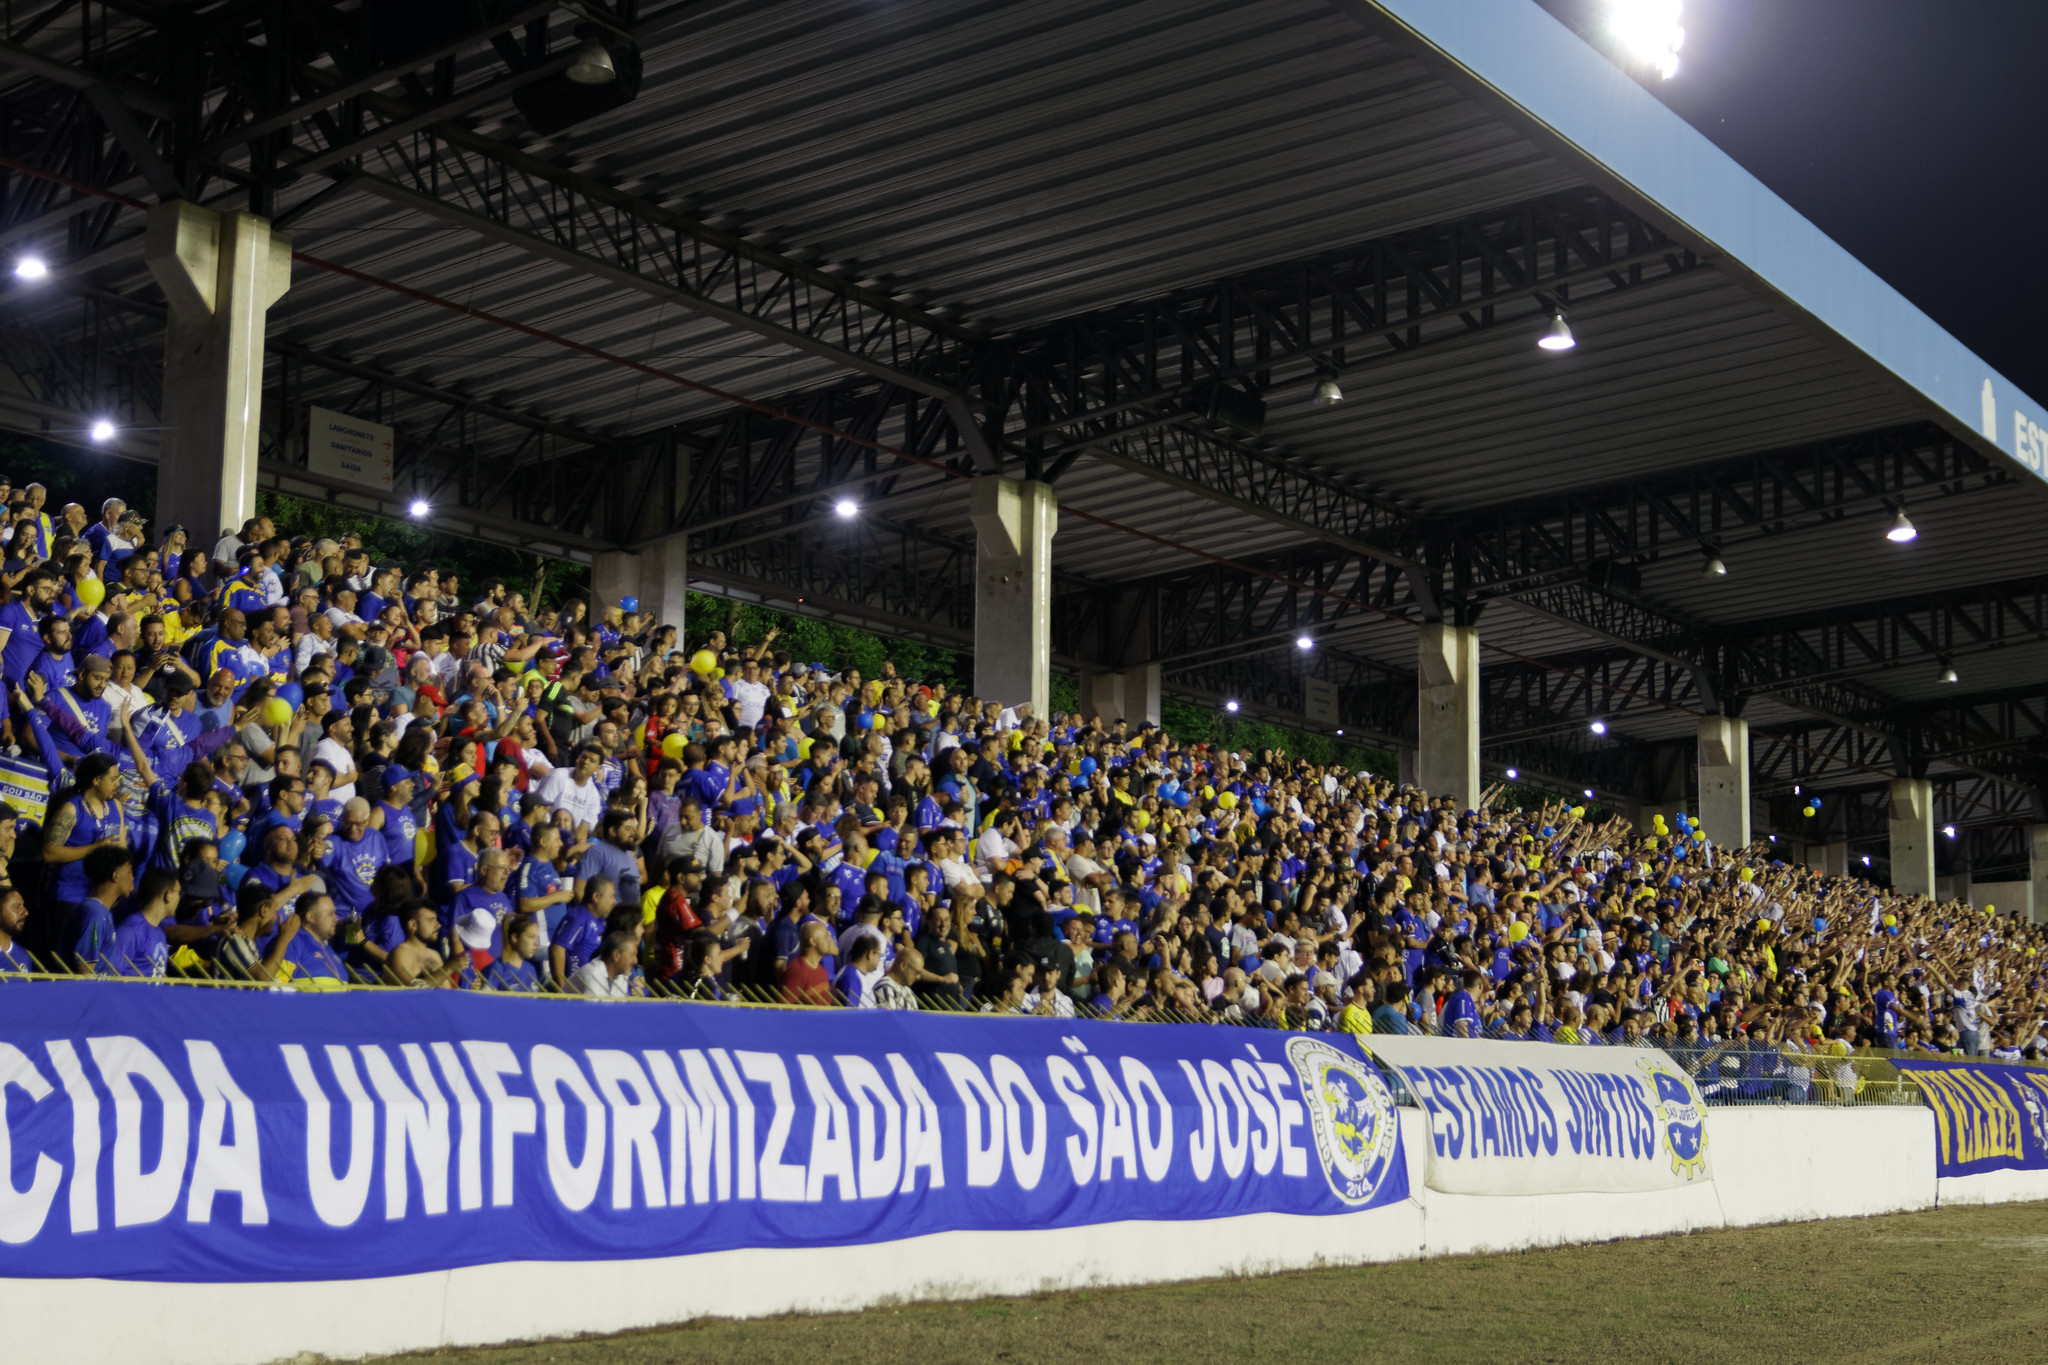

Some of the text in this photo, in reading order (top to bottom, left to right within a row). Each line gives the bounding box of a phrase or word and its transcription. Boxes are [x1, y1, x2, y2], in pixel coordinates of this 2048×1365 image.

[329, 423, 374, 441] LANCHONETE
[2, 785, 23, 796] SOU
[24, 790, 42, 802] SÃO
[279, 1040, 945, 1228] UNIFORMIZADA
[935, 1052, 1047, 1190] DO
[1046, 1036, 1173, 1186] SÃO
[1177, 1044, 1306, 1181] JOSÉ
[1397, 1064, 1655, 1160] ESTAMOS JUNTOS
